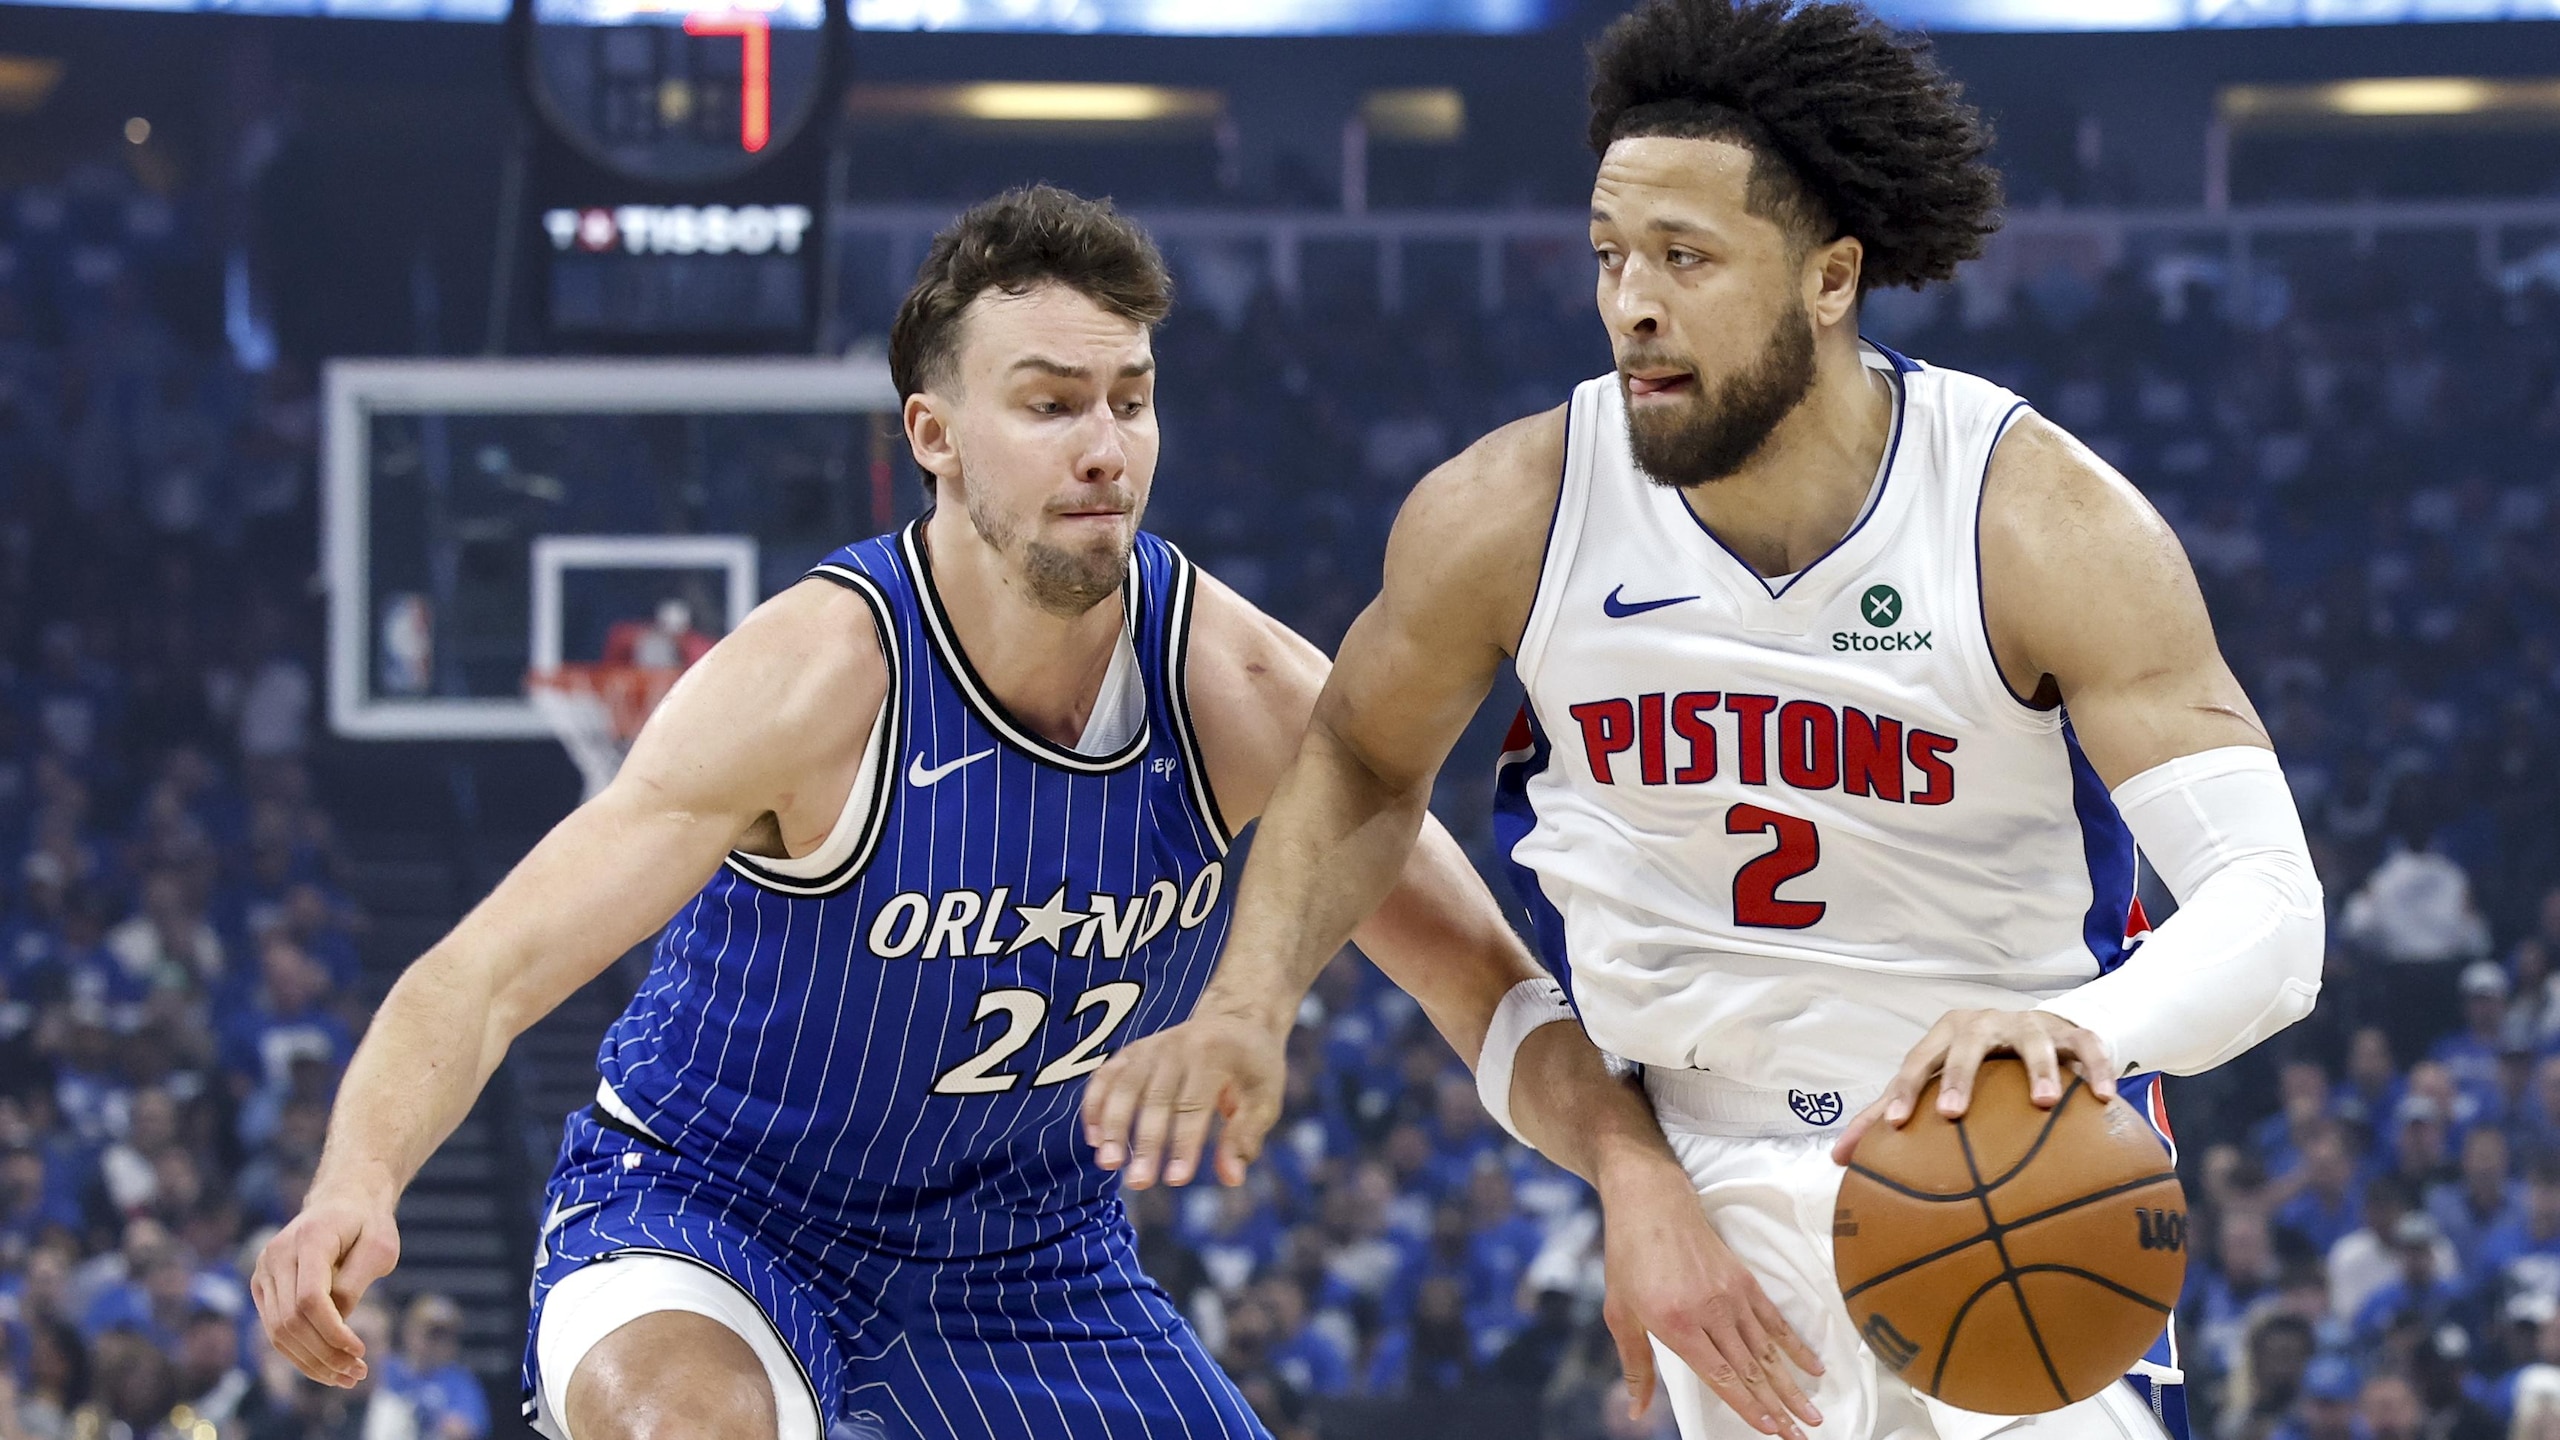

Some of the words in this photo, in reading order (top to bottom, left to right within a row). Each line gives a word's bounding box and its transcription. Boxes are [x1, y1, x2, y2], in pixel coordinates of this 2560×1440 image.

[615, 204, 812, 255] TISSOT
[1832, 630, 1932, 652] StockX
[1569, 691, 1958, 805] PISTONS
[1725, 802, 1827, 929] 2
[930, 981, 1145, 1097] 22
